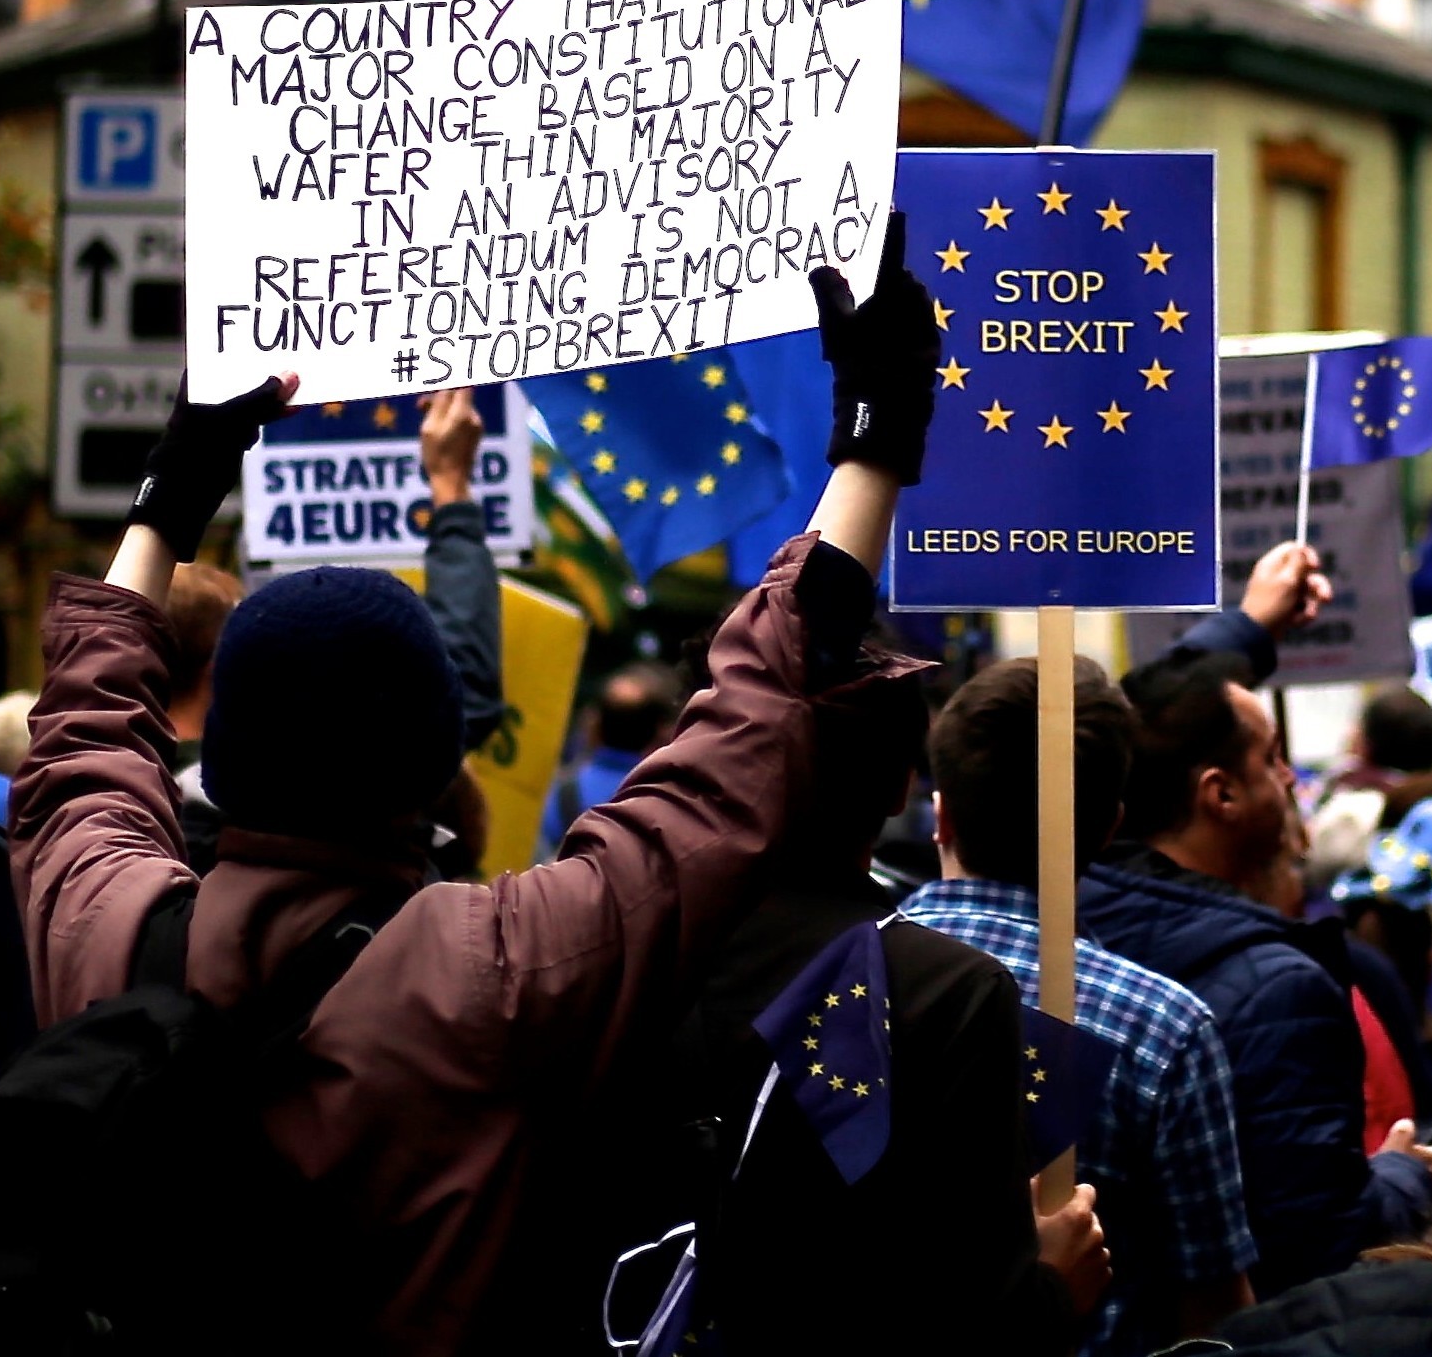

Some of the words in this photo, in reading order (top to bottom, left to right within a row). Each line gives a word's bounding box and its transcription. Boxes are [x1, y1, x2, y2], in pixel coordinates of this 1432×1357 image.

[189, 10, 224, 55] A
[232, 50, 414, 105] MAJOR
[289, 95, 503, 162] CHANGE
[538, 56, 692, 130] BASED
[721, 33, 778, 93] ON
[805, 17, 832, 71] A
[253, 148, 431, 200] WAFER
[471, 125, 597, 185] THIN
[629, 59, 860, 162] MAJORITY
[352, 194, 414, 248] IN
[450, 183, 512, 238] AN
[548, 130, 791, 224] ADVISORY
[255, 223, 589, 302] REFERENDUM
[628, 207, 683, 259] IS
[717, 178, 801, 241] NOT
[833, 161, 859, 215] A
[218, 271, 586, 353] FUNCTIONING
[619, 200, 879, 305] DEMOCRACY
[995, 270, 1104, 303] STOP
[391, 289, 745, 384] #STOPBREXIT
[982, 320, 1134, 353] BREXIT
[264, 451, 508, 493] STRATFD
[266, 495, 511, 544] 4EUROE
[907, 530, 1001, 553] LEEDS
[1009, 530, 1069, 553] FOR
[1077, 531, 1195, 554] EUROPE
